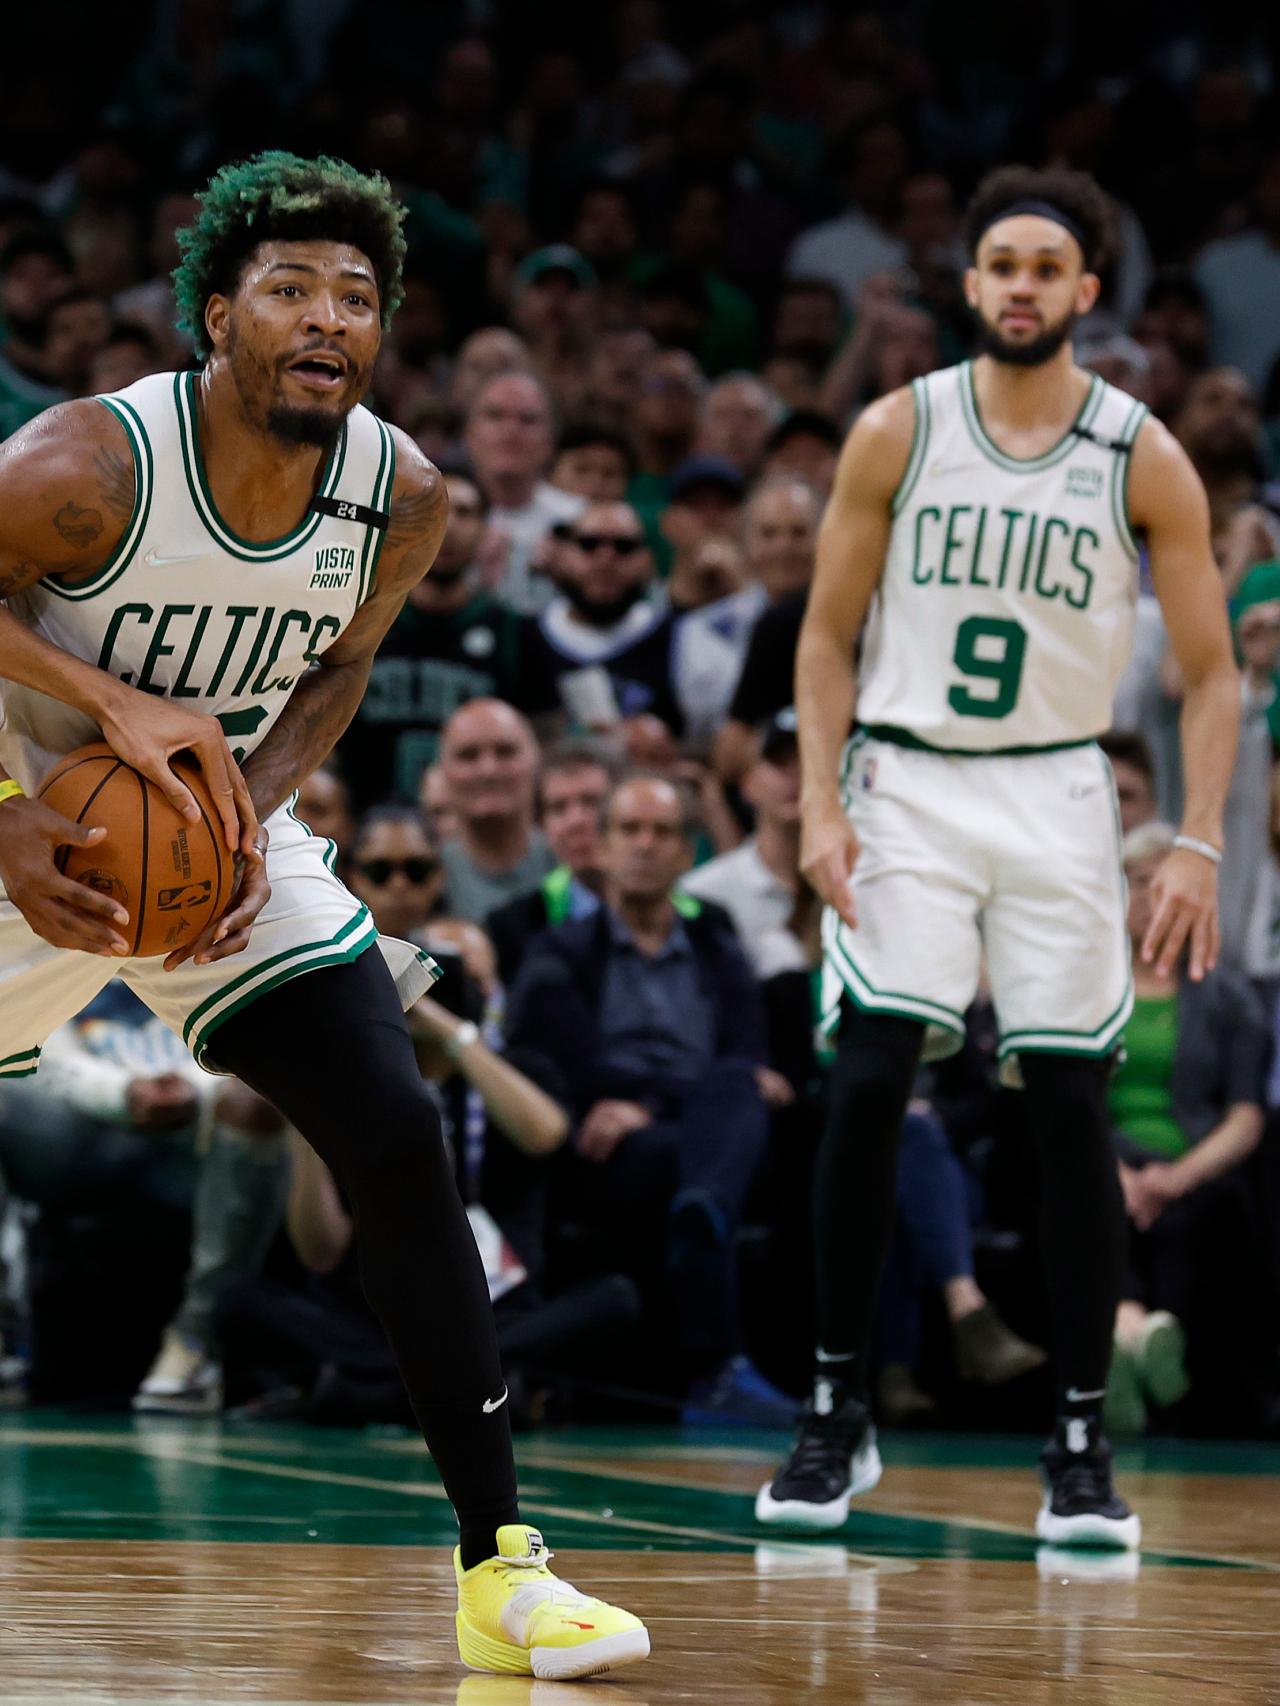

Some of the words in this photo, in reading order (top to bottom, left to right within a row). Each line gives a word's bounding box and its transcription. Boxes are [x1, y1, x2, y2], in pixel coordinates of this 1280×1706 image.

[337, 502, 358, 520] 24
[309, 572, 352, 589] PRINT
[316, 547, 355, 571] VISTA
[912, 504, 1100, 610] CELTICS
[98, 603, 341, 698] CELTICS
[947, 615, 1028, 719] 9
